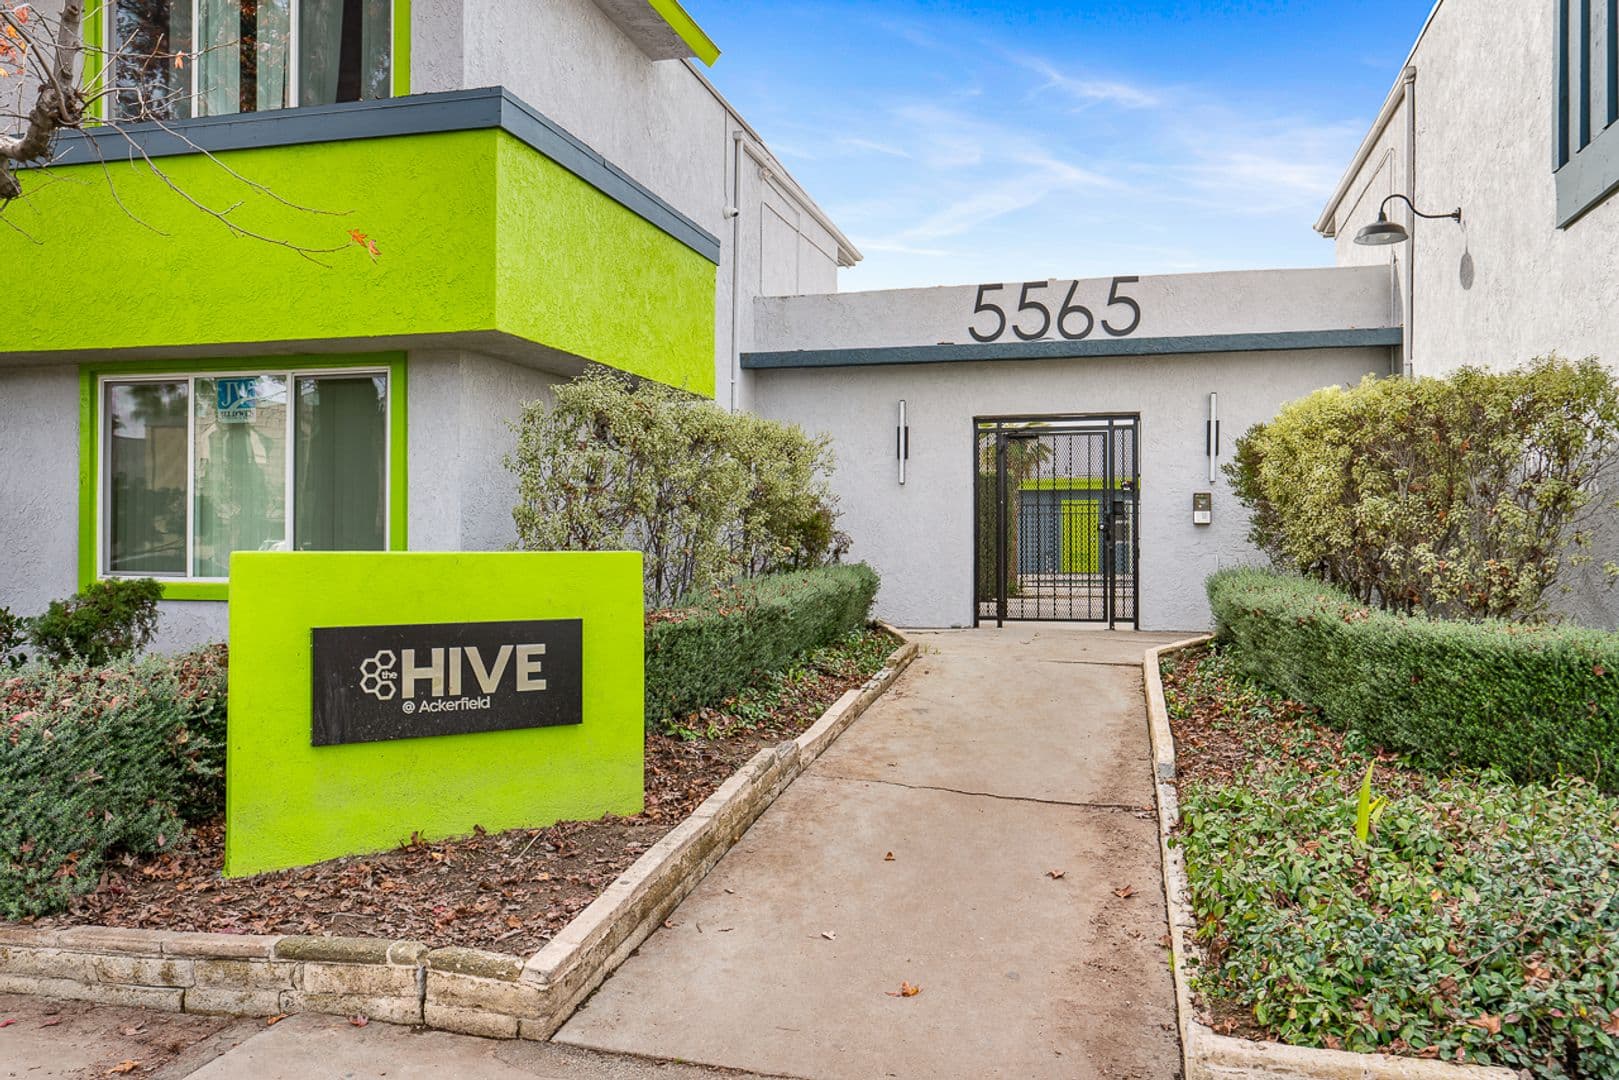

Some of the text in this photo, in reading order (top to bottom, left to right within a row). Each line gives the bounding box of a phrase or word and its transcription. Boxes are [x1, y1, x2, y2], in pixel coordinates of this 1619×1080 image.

[968, 276, 1141, 342] 5565
[381, 643, 547, 699] the HIVE
[402, 695, 491, 714] @ Ackerfield
